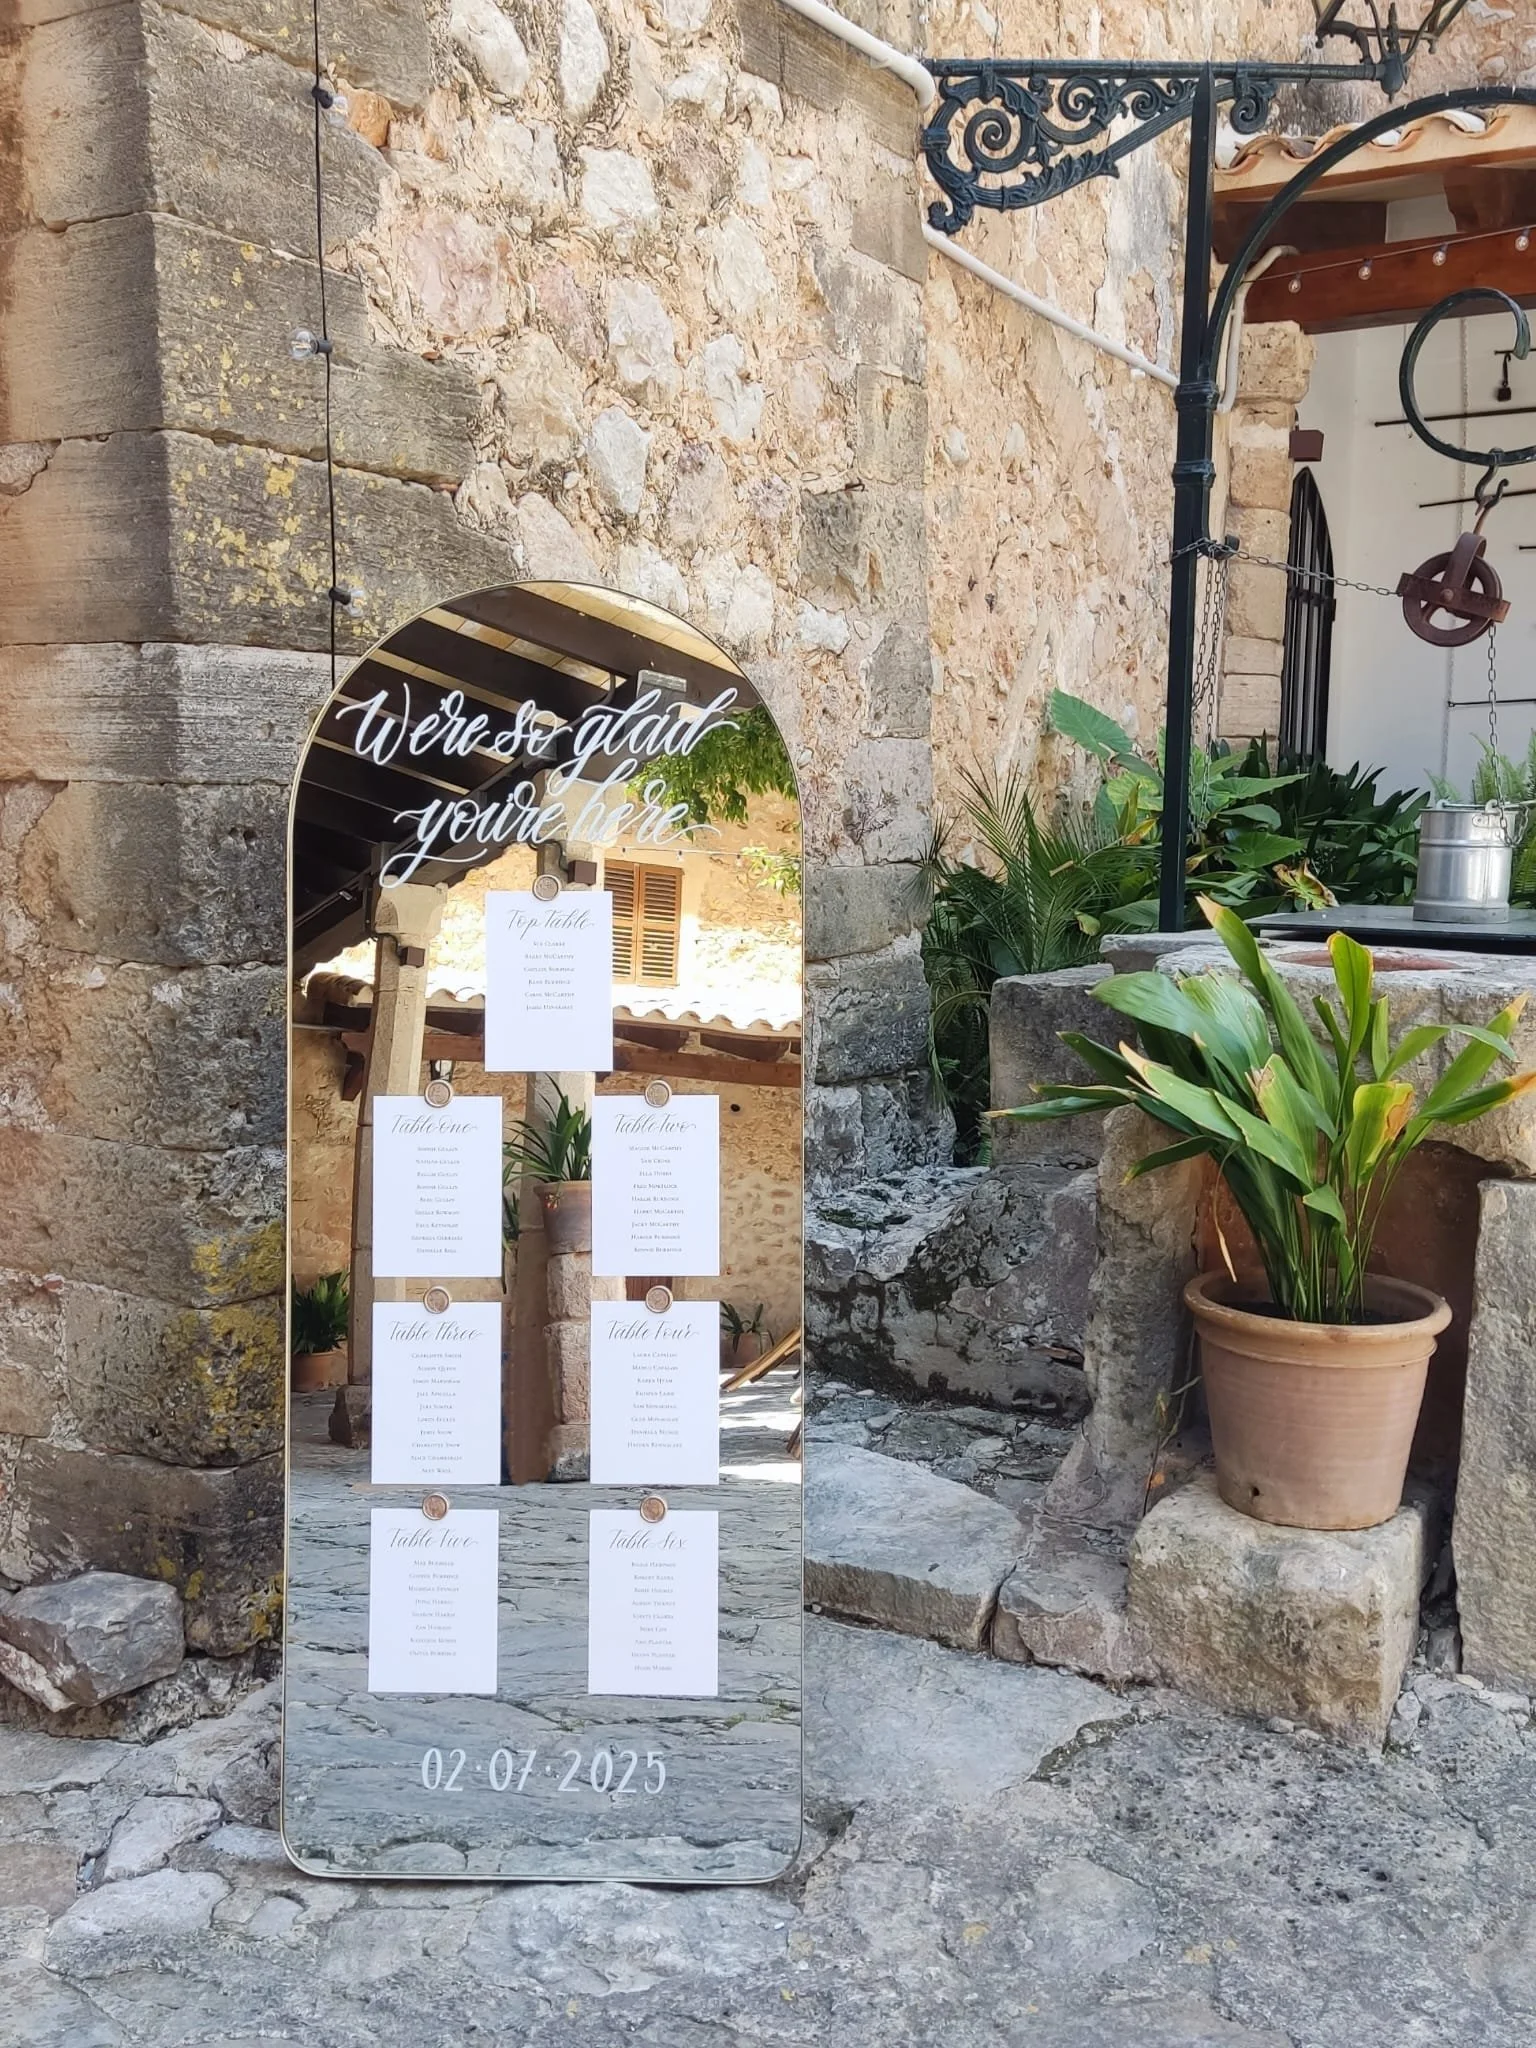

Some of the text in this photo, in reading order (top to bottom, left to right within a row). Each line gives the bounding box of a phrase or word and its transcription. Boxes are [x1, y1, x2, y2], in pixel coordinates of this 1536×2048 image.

[336, 682, 741, 797] We're so glad
[379, 758, 722, 889] you're here
[507, 908, 542, 941] Top
[391, 1113, 435, 1135] Table
[613, 1112, 658, 1135] Table
[389, 1319, 487, 1341] Table Three
[607, 1319, 700, 1341] Table Four
[387, 1526, 436, 1549] Table
[607, 1528, 652, 1551] Table
